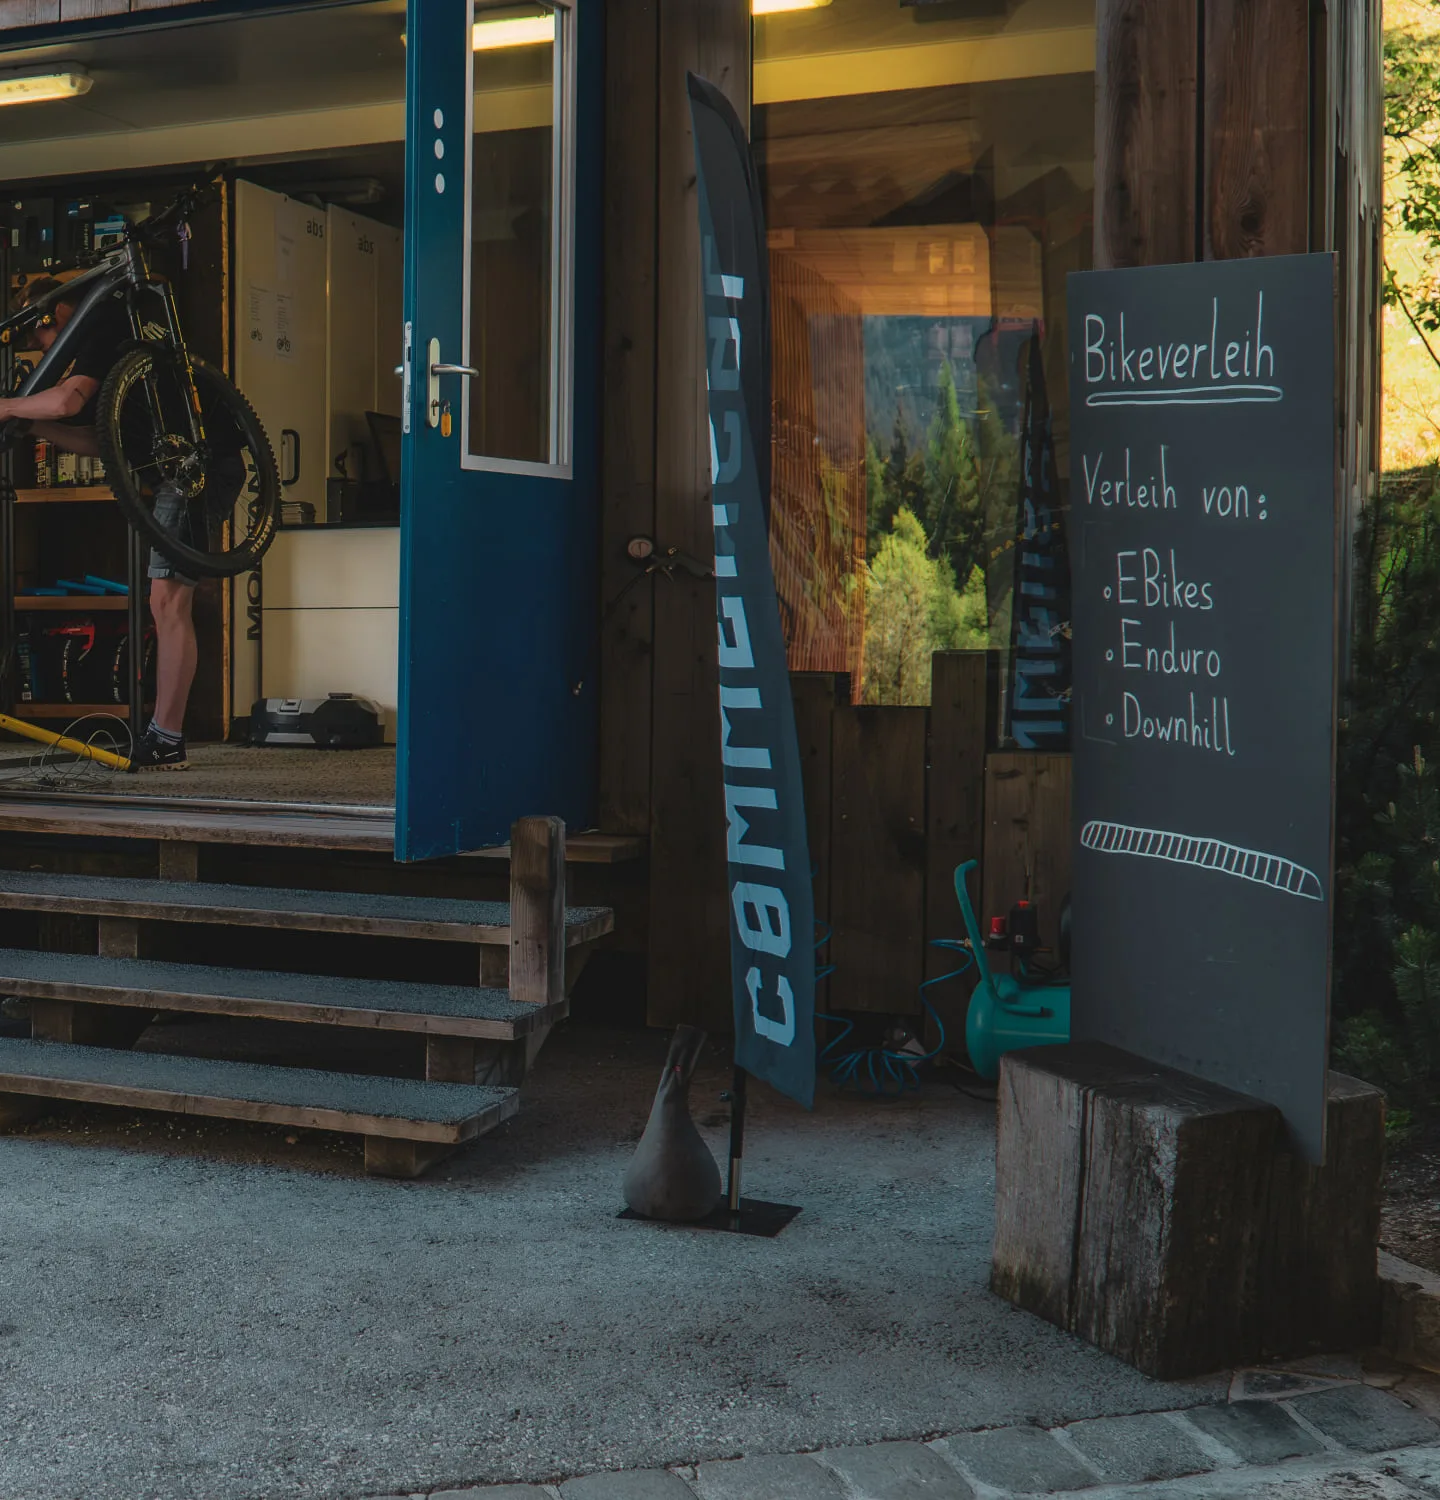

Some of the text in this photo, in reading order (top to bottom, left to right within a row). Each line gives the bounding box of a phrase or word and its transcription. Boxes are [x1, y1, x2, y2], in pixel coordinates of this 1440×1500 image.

[306, 217, 324, 239] abs
[357, 235, 375, 254] abs
[1085, 289, 1275, 383] Bikeverleih
[1082, 444, 1268, 520] Verleih von:
[1117, 548, 1213, 610] EBikes
[1121, 618, 1221, 677] Enduro
[1123, 692, 1236, 756] Downhill
